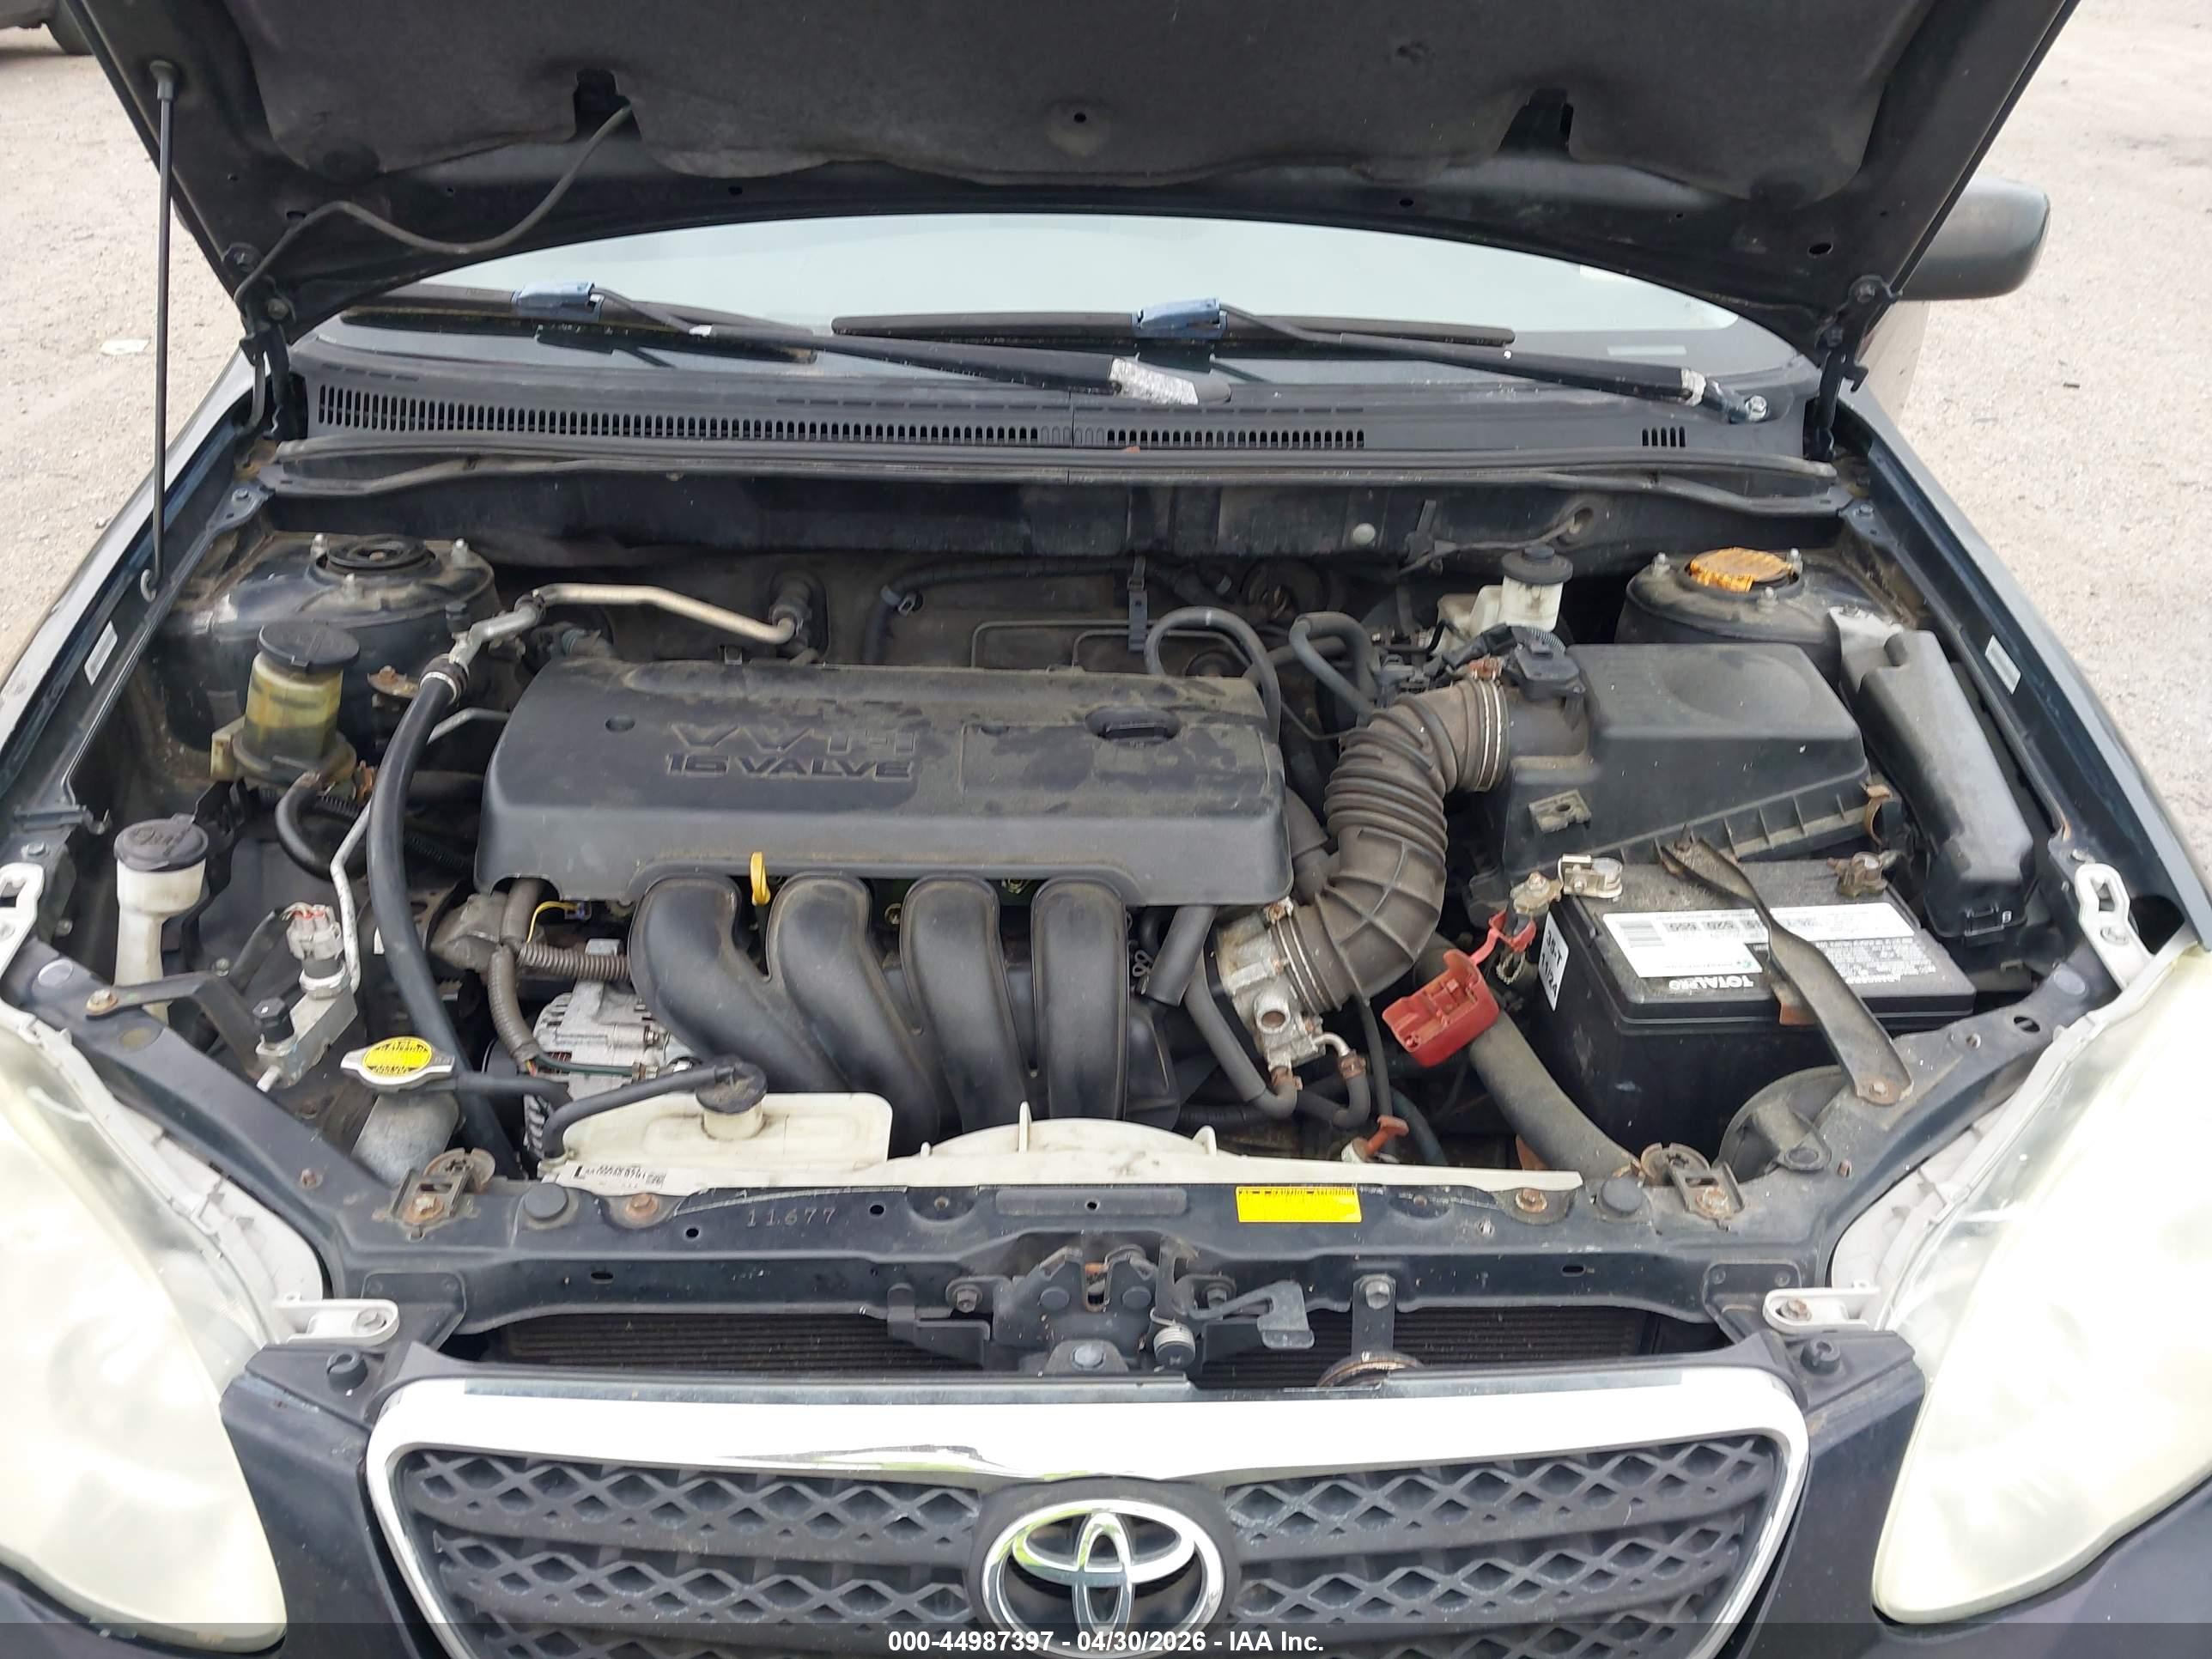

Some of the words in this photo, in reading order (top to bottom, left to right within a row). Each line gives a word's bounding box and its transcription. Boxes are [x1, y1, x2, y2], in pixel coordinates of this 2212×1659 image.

[666, 754, 729, 778] 16
[735, 756, 914, 781] VALVE
[1541, 952, 1559, 998] 11/24
[747, 1207, 836, 1227] 11677
